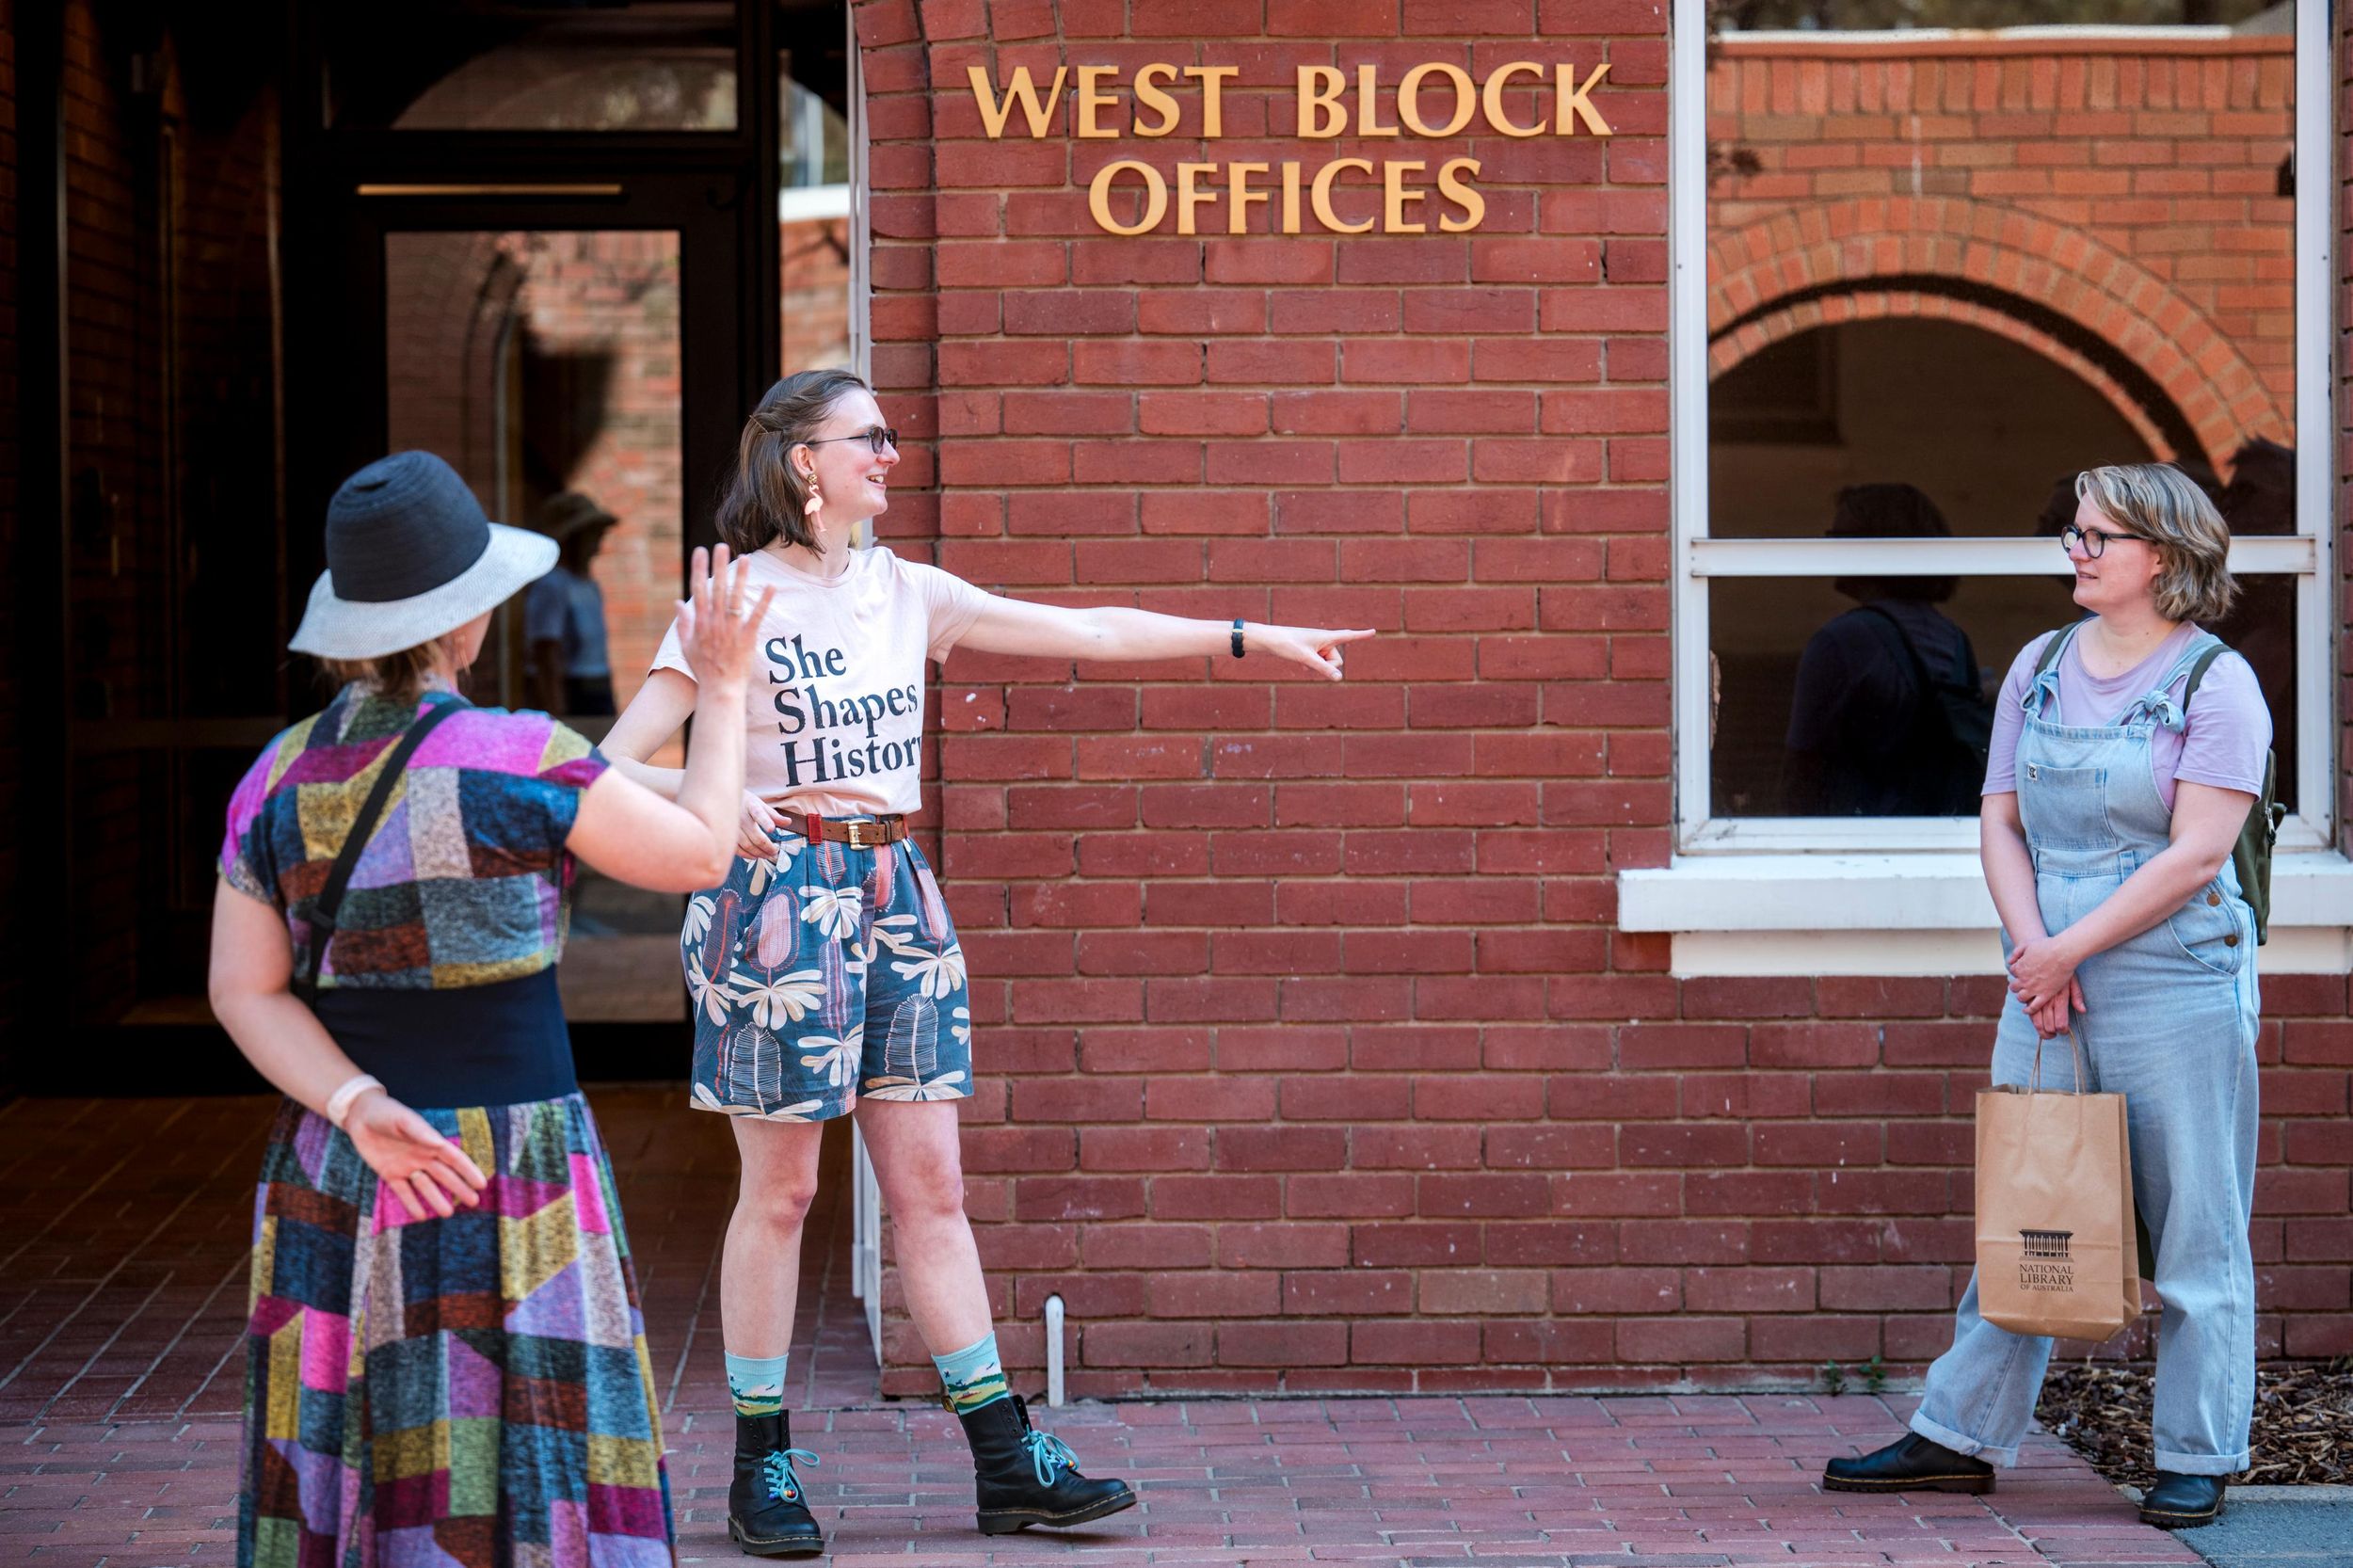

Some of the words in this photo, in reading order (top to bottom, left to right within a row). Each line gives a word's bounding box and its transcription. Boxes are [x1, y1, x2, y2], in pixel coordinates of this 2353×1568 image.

[967, 63, 1240, 139] WEST
[1296, 61, 1614, 138] BLOCK
[1088, 158, 1486, 236] OFFICES
[764, 633, 847, 685] She
[774, 683, 919, 739] Shapes
[779, 736, 921, 788] Histor
[2019, 1263, 2074, 1275] NATIONAL
[2020, 1272, 2073, 1286] LIBRARY
[2032, 1284, 2074, 1293] AUSTRALIA
